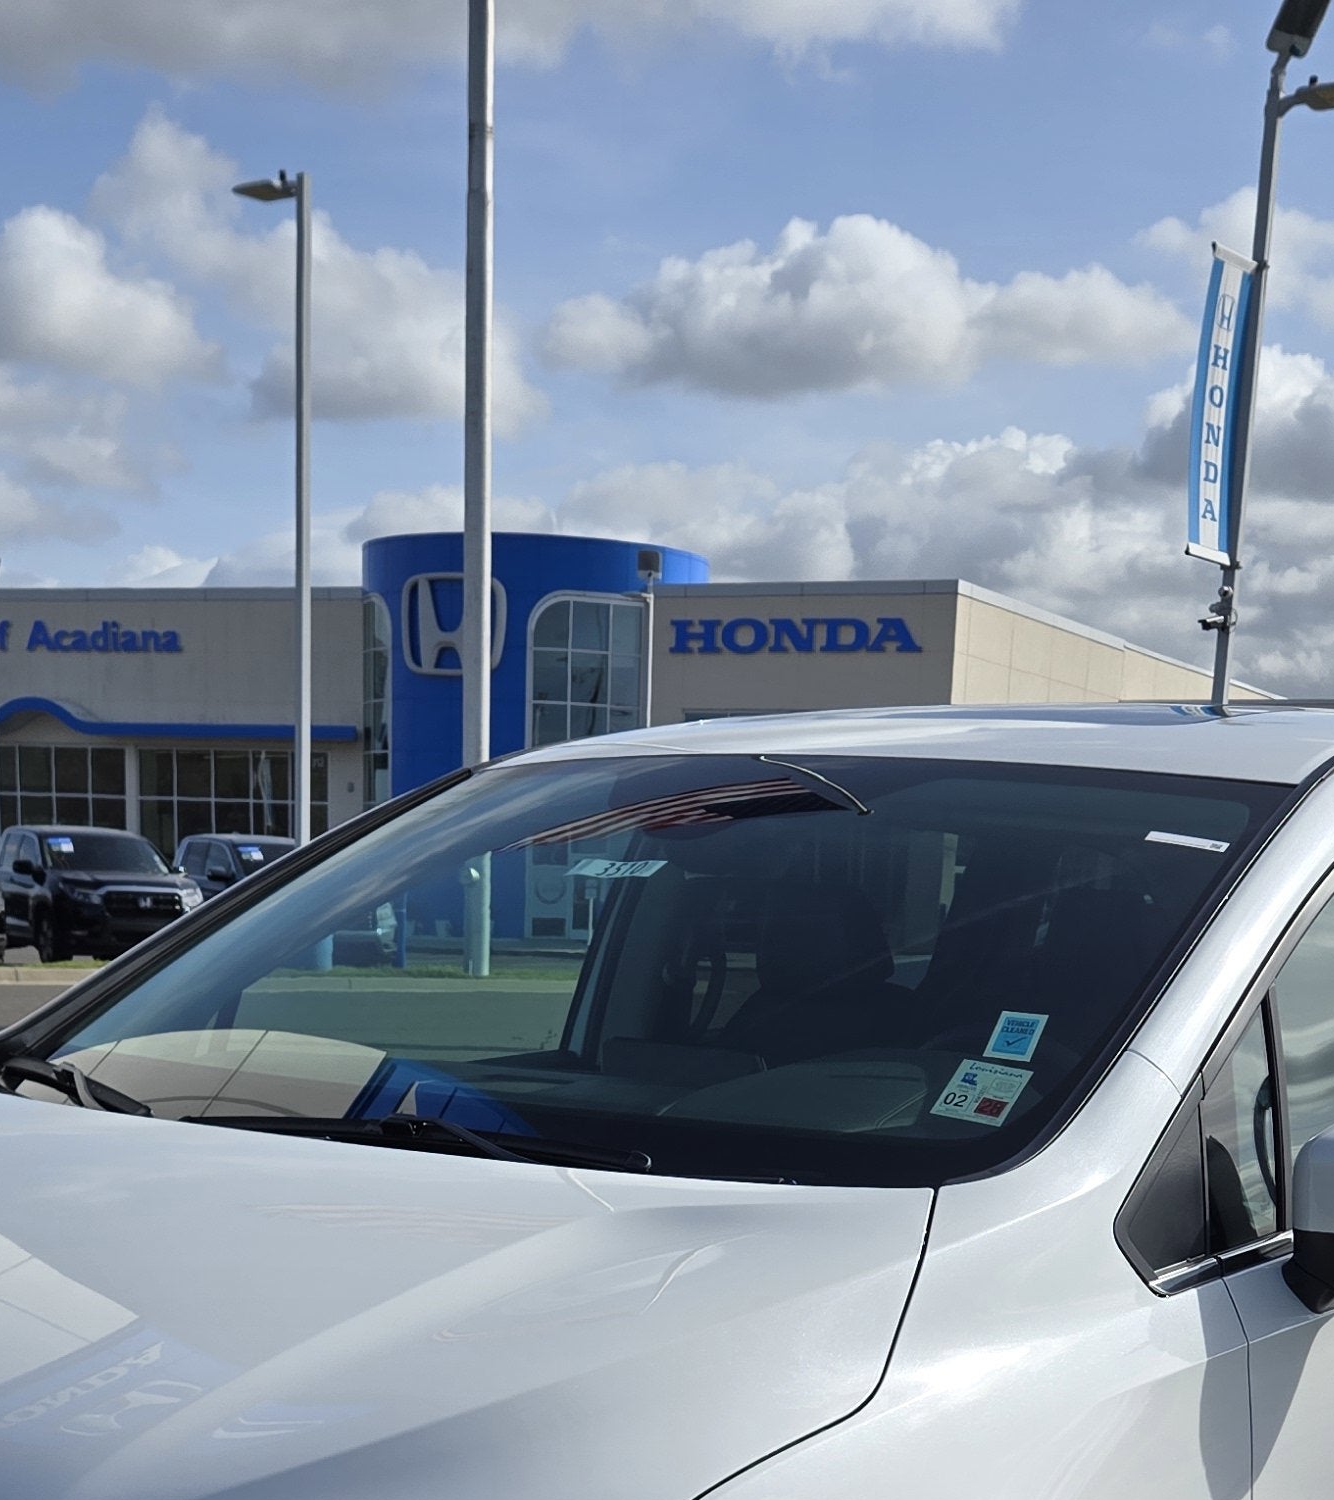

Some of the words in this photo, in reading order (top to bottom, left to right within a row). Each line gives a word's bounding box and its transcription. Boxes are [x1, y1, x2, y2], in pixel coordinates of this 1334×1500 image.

[1201, 344, 1230, 523] HONDA
[26, 620, 182, 652] Acadiana
[669, 617, 923, 654] HONDA
[1002, 1026, 1036, 1035] CLEANED
[969, 1062, 1024, 1079] Louisiana
[943, 1092, 969, 1107] 02
